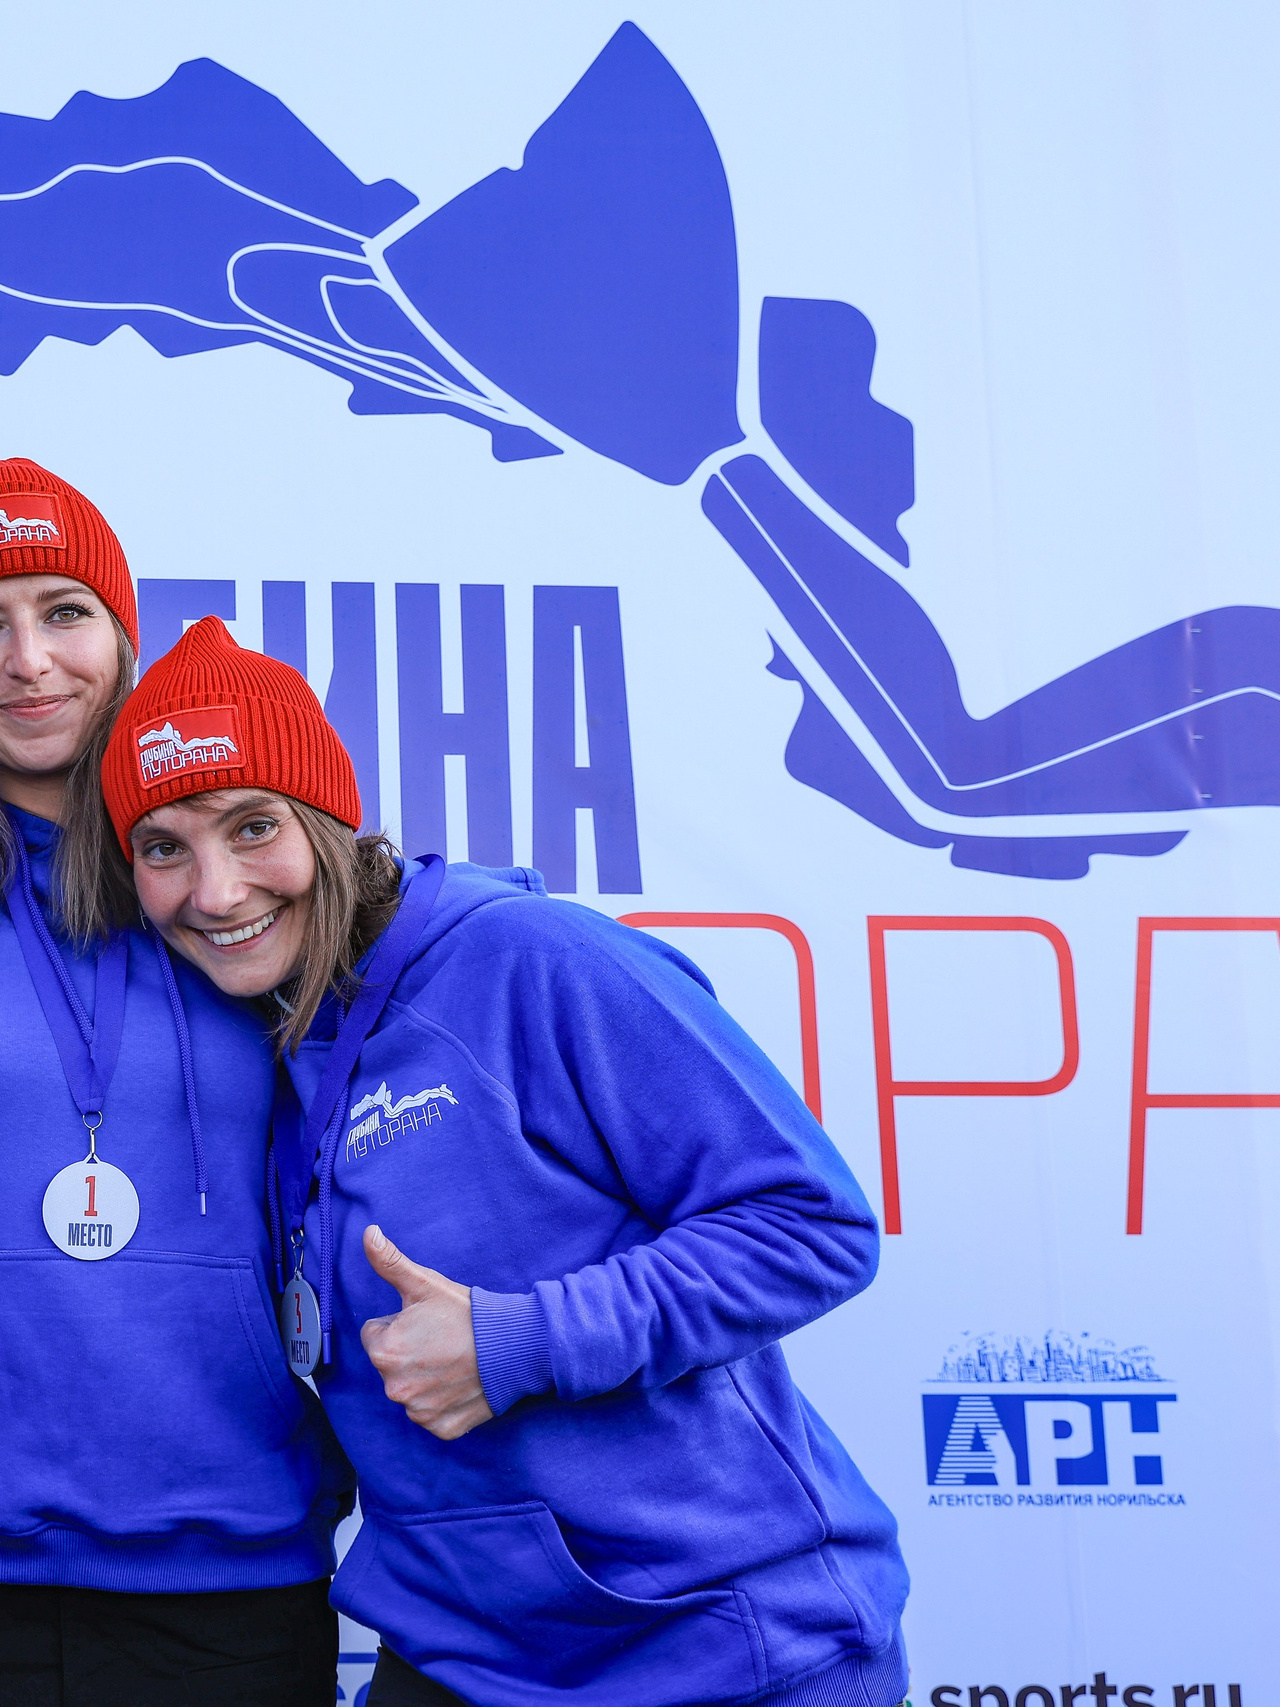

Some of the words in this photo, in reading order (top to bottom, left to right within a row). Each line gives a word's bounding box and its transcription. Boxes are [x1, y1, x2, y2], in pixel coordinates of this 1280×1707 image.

[140, 740, 176, 766] ГЛУБИНА
[141, 745, 229, 781] ПУТОРАНА
[84, 1175, 98, 1217] 1
[67, 1222, 113, 1248] МЕСТО
[294, 1293, 302, 1334] 3
[288, 1340, 310, 1365] МЕСТО
[927, 1494, 1013, 1507] АГЕНТСТВО
[1017, 1494, 1093, 1507] РАЗВИТИЯ
[1096, 1494, 1186, 1507] НОРИЛЬСКА
